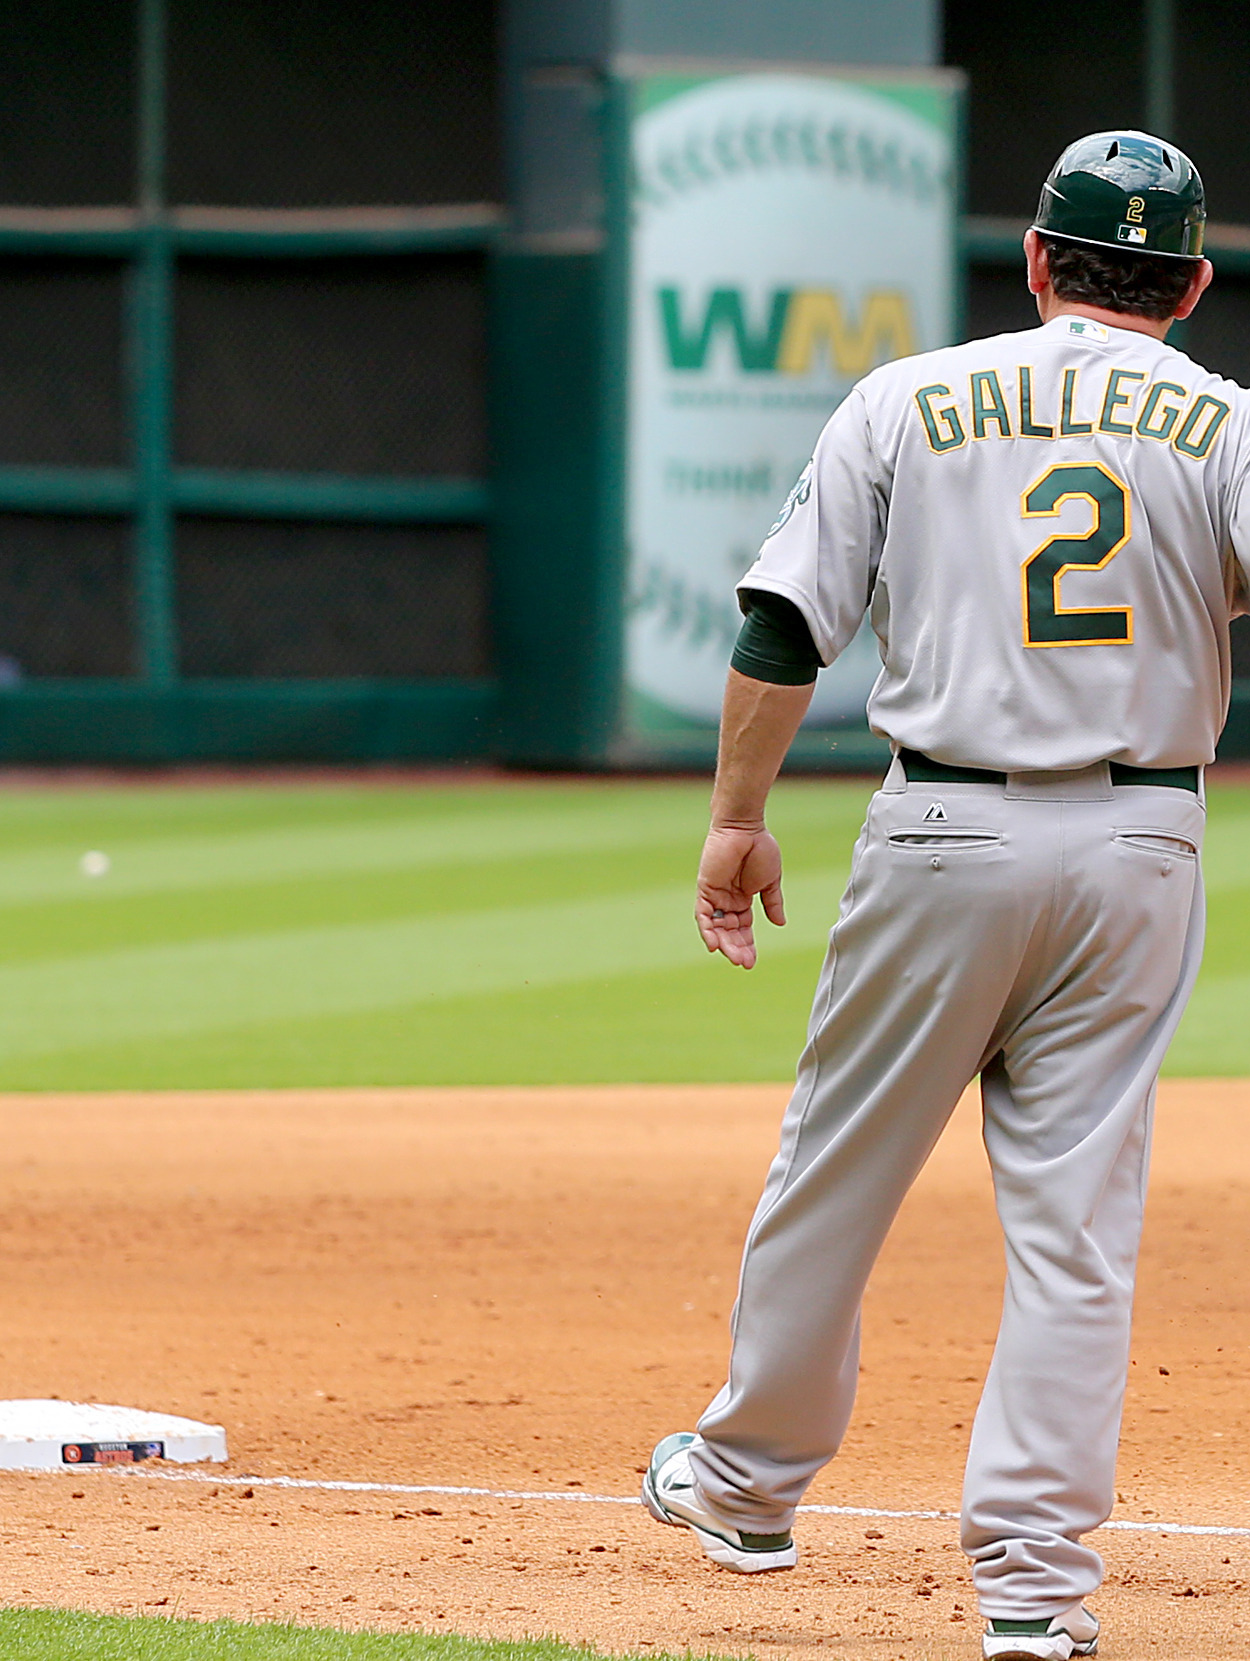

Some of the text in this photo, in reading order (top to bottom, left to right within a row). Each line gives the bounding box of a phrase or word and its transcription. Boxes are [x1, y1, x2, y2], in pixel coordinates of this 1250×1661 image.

[1126, 196, 1146, 223] 2
[657, 286, 916, 374] WM
[912, 365, 1231, 460] GALLEGO
[1020, 461, 1134, 648] 2
